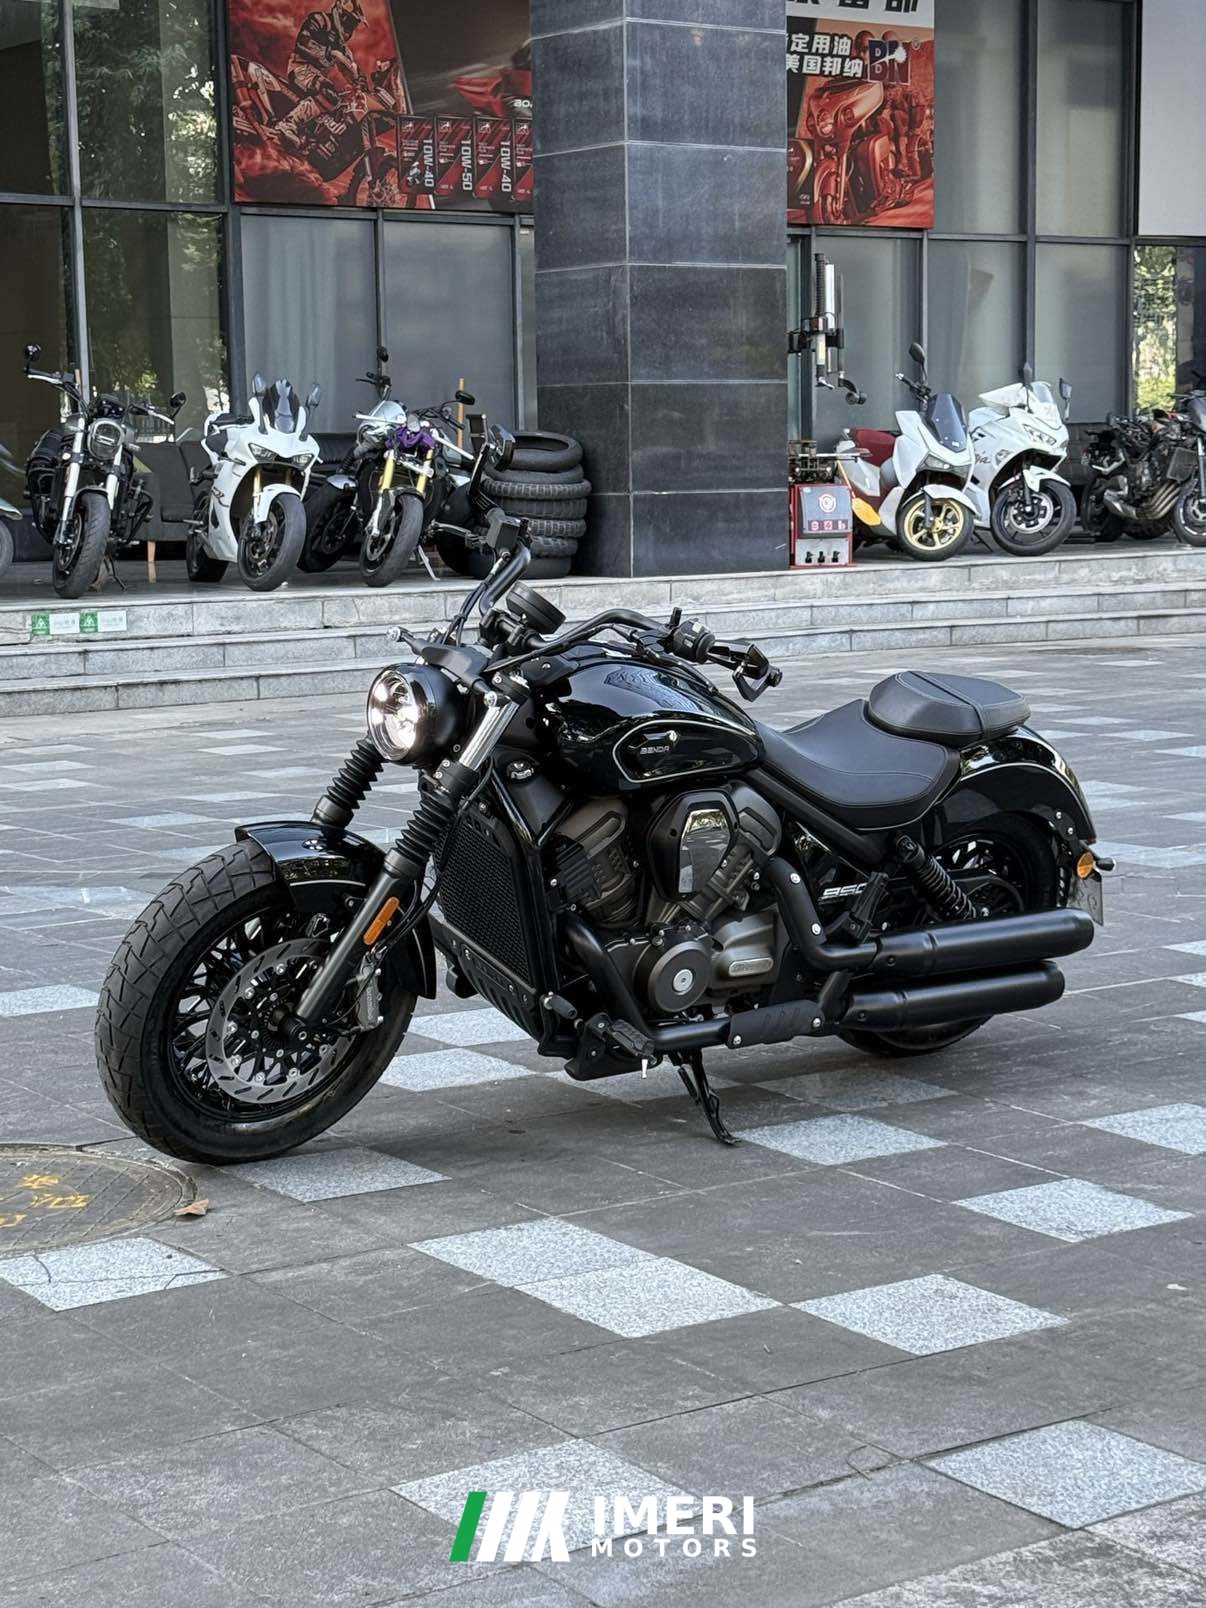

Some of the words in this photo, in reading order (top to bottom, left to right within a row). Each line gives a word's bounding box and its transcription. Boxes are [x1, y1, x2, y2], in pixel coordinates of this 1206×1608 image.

[786, 33, 852, 56] 定用油
[423, 139, 434, 187] 10W-40
[461, 139, 473, 191] 10W-50
[500, 141, 512, 192] 10W-40
